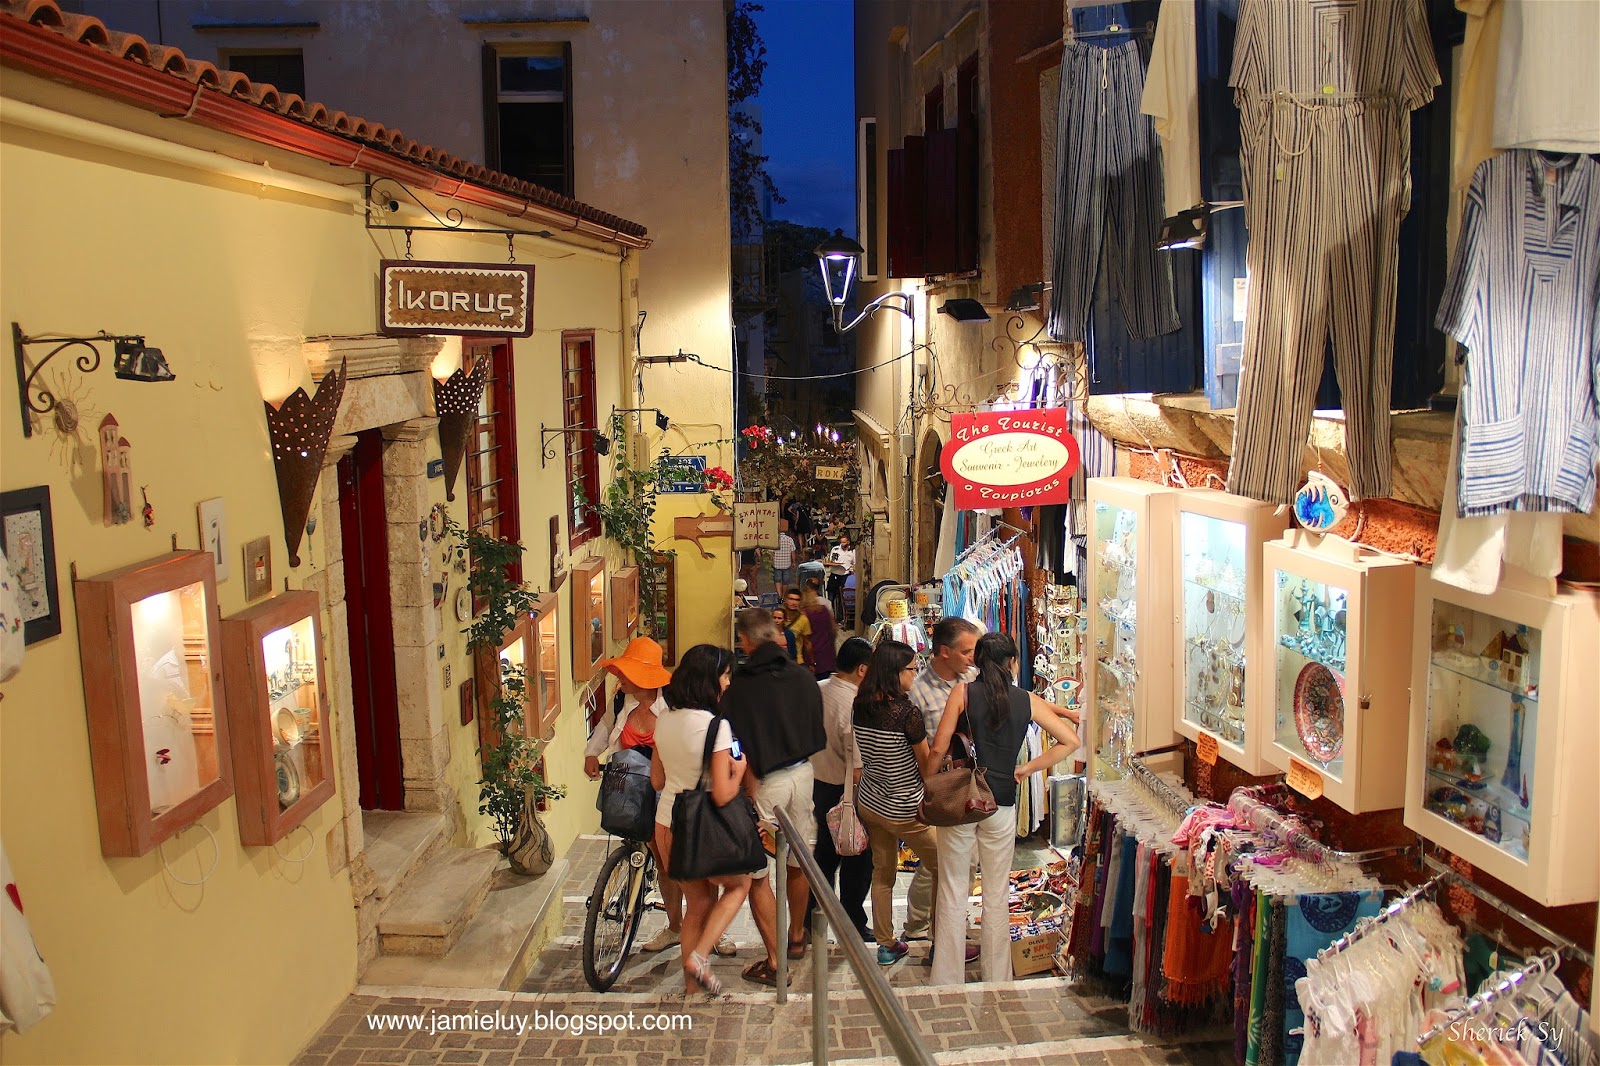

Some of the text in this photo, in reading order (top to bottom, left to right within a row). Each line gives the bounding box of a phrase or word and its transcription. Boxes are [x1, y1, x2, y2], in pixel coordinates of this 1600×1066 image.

[956, 417, 1062, 441] The Tourist
[980, 439, 1037, 458] Greek Art
[959, 459, 1003, 472] Souvenir
[743, 533, 770, 541] SPACE
